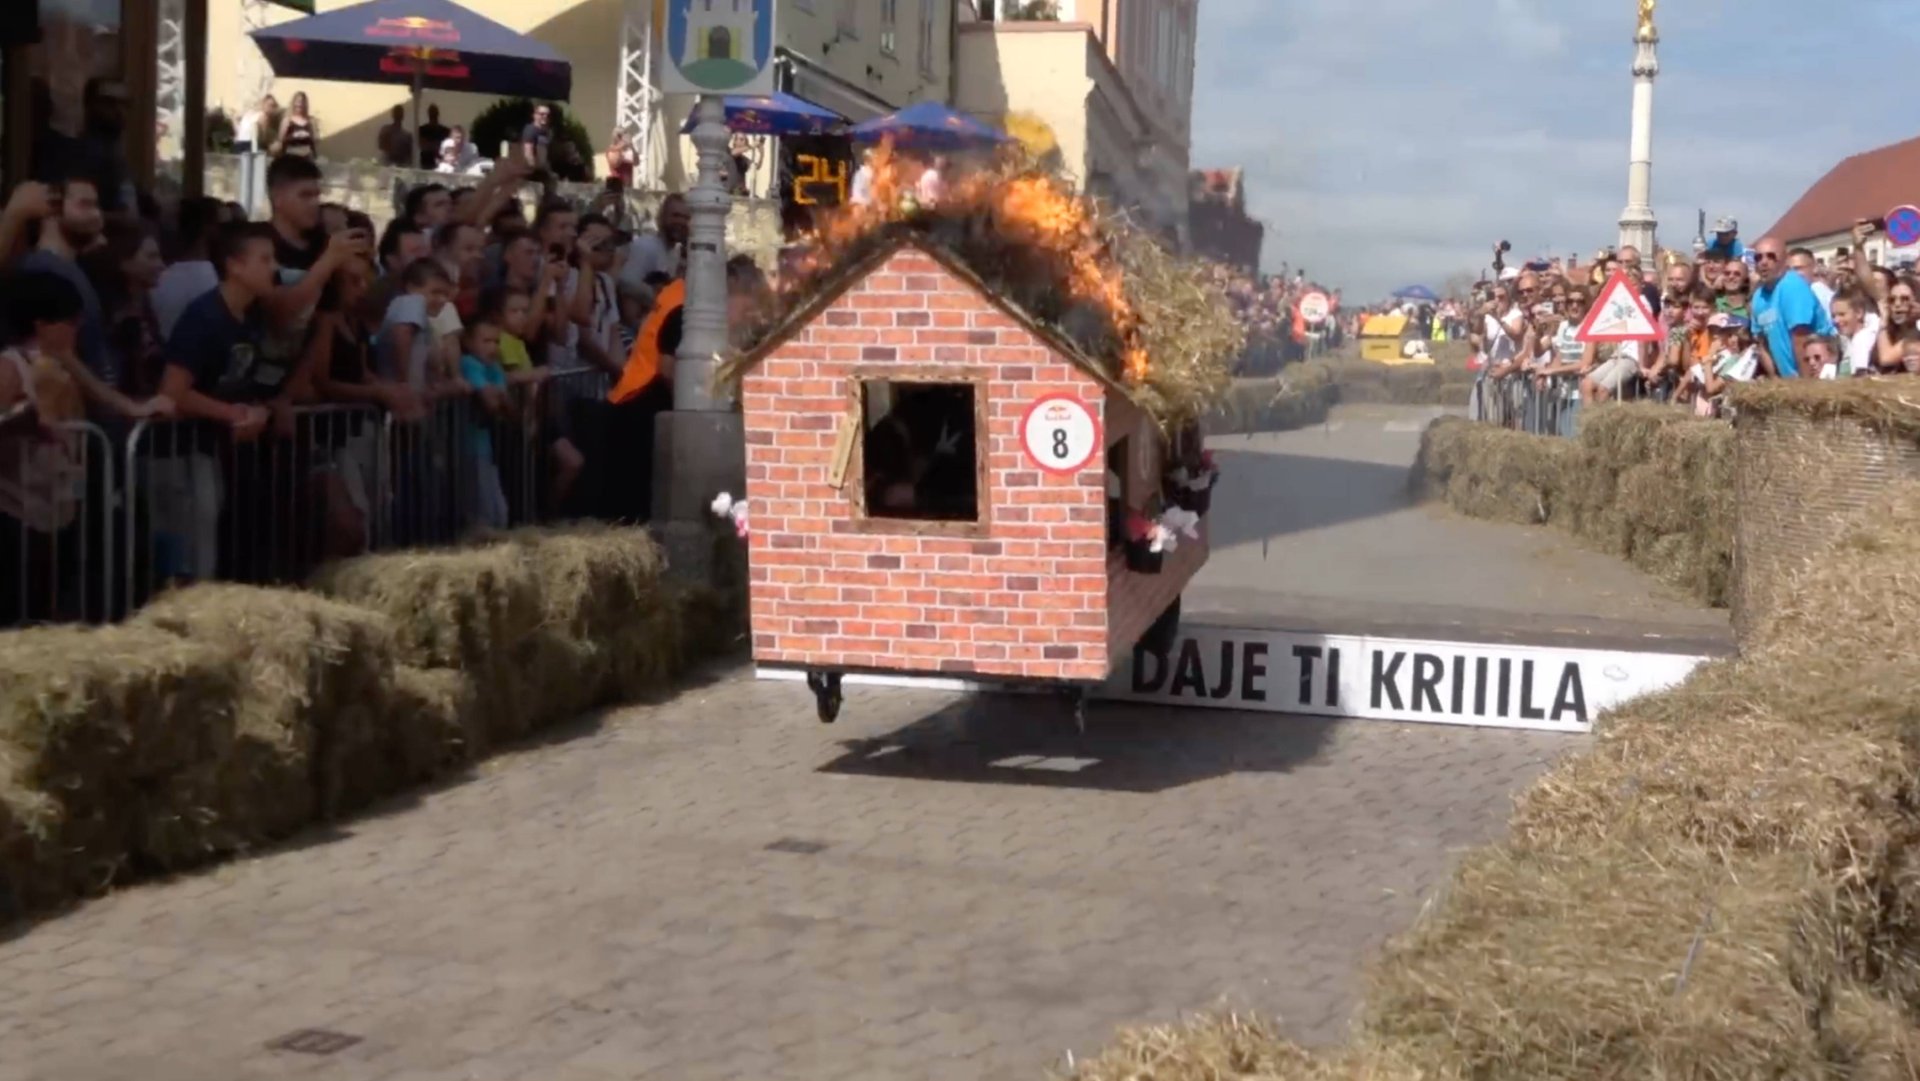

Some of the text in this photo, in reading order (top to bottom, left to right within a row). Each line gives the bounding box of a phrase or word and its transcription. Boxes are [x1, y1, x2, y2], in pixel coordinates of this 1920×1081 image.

[794, 154, 847, 205] 24
[1052, 428, 1069, 459] 8
[1131, 639, 1588, 723] DAJE TI KRIIILA
